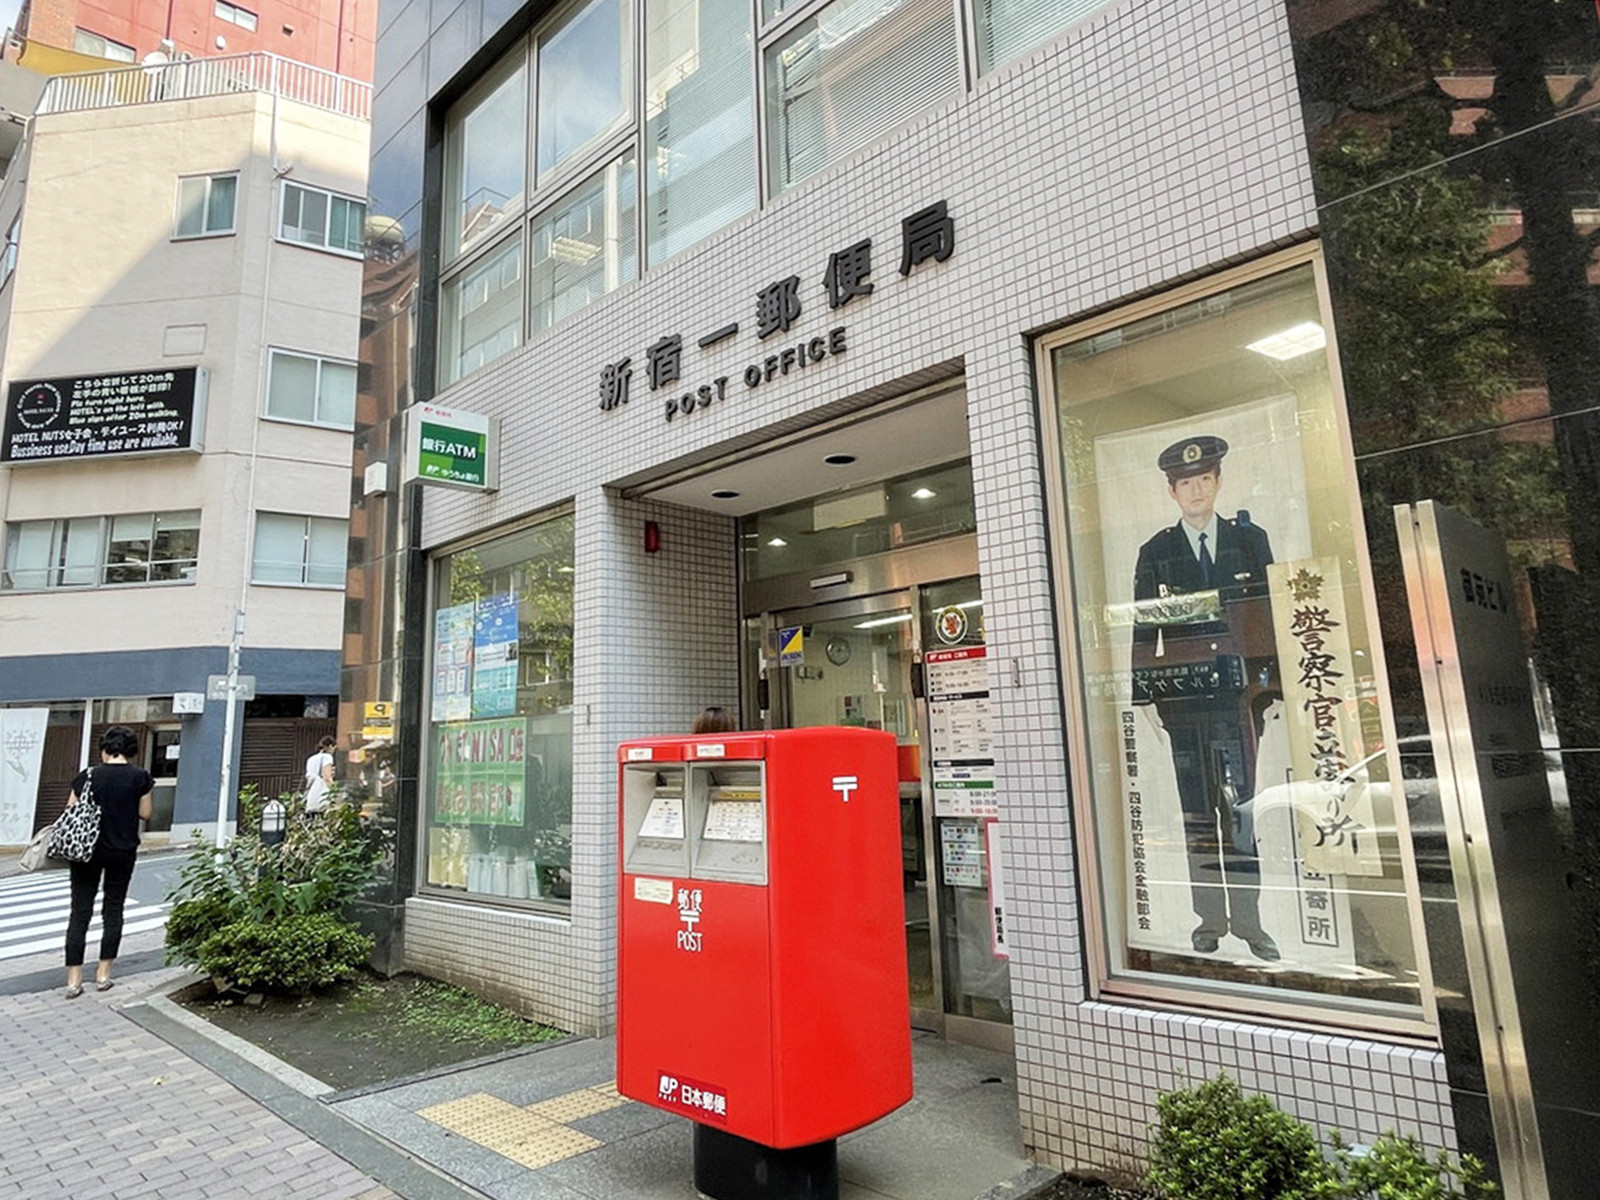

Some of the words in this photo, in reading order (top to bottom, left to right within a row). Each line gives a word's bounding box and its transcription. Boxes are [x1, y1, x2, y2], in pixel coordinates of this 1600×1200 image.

[600, 200, 955, 412] 新宿一郵便局
[665, 376, 728, 423] POST
[744, 326, 847, 388] OFFICE
[11, 432, 39, 444] HOTEL
[87, 438, 107, 452] time
[107, 438, 123, 450] use
[124, 437, 140, 449] are
[422, 437, 477, 458] 銀行ATM
[677, 888, 703, 912] 郵便
[677, 930, 703, 952] POST
[659, 1075, 678, 1096] JP
[681, 1084, 727, 1116] 日本郵便
